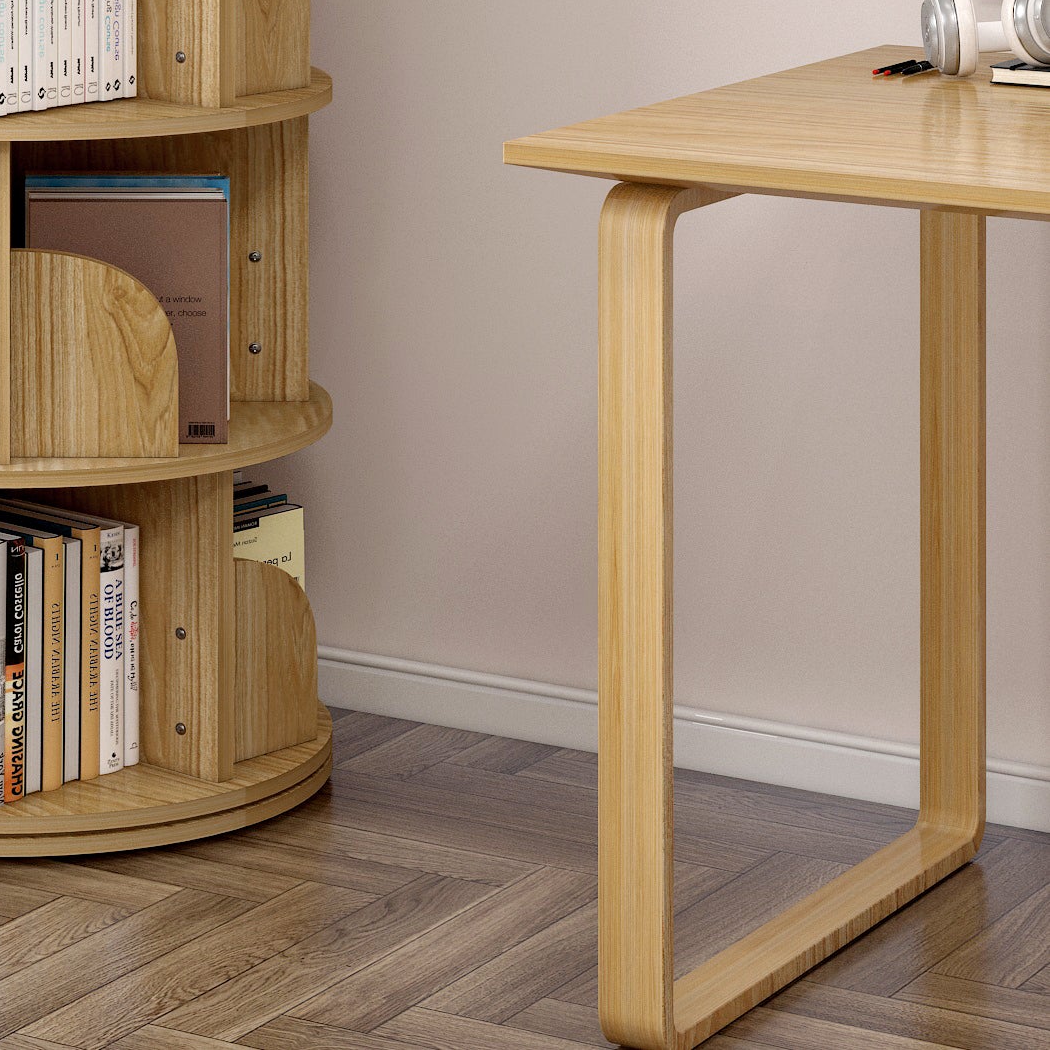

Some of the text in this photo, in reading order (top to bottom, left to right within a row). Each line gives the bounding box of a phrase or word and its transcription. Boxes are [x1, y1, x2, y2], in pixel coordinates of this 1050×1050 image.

[172, 295, 201, 303] window
[177, 309, 207, 317] choose
[104, 584, 114, 660] OF BLOOD
[115, 579, 123, 661] A BLUE SEA
